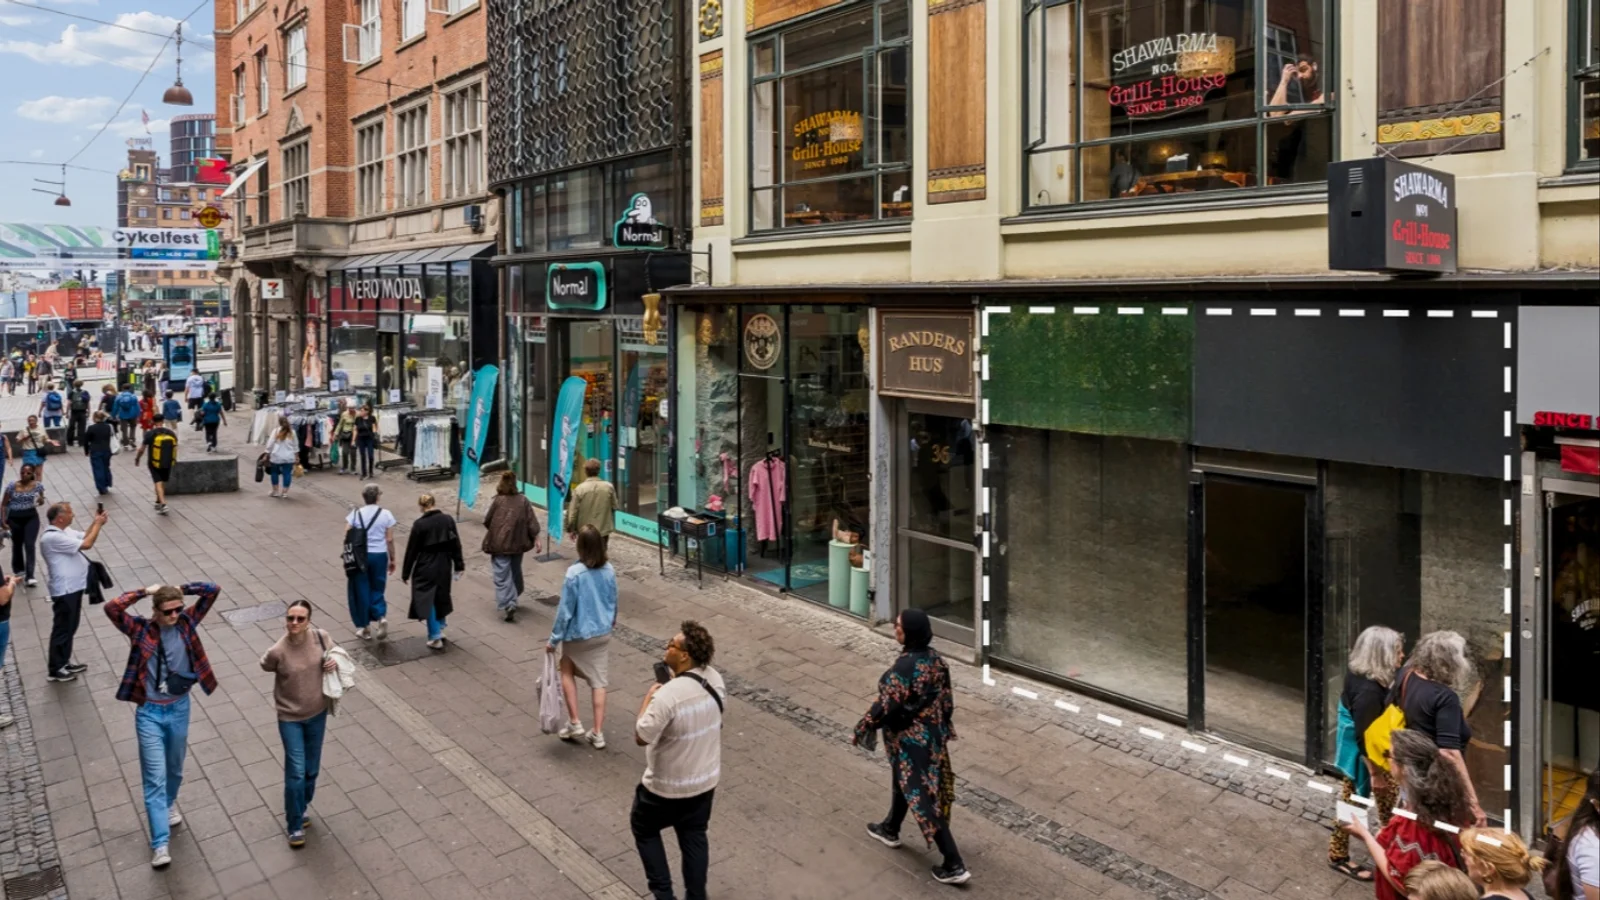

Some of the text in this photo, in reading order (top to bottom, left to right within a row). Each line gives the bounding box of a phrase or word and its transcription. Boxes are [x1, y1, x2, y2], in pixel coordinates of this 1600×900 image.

[1112, 32, 1219, 72] SHAWARMA
[1106, 71, 1227, 106] Grill-House
[1126, 96, 1204, 116] SINCE 1980
[794, 110, 860, 138] SHAWARMA
[803, 159, 826, 170] SINCE
[1393, 172, 1448, 209] SHAWARMA
[112, 230, 200, 246] Cykelfest
[623, 226, 662, 242] Normal
[348, 278, 423, 299] VERO MODA
[553, 277, 588, 296] Normal
[888, 331, 966, 356] RANDERS
[909, 355, 943, 373] HUS
[1533, 411, 1592, 430] SINCE
[931, 443, 951, 464] 36
